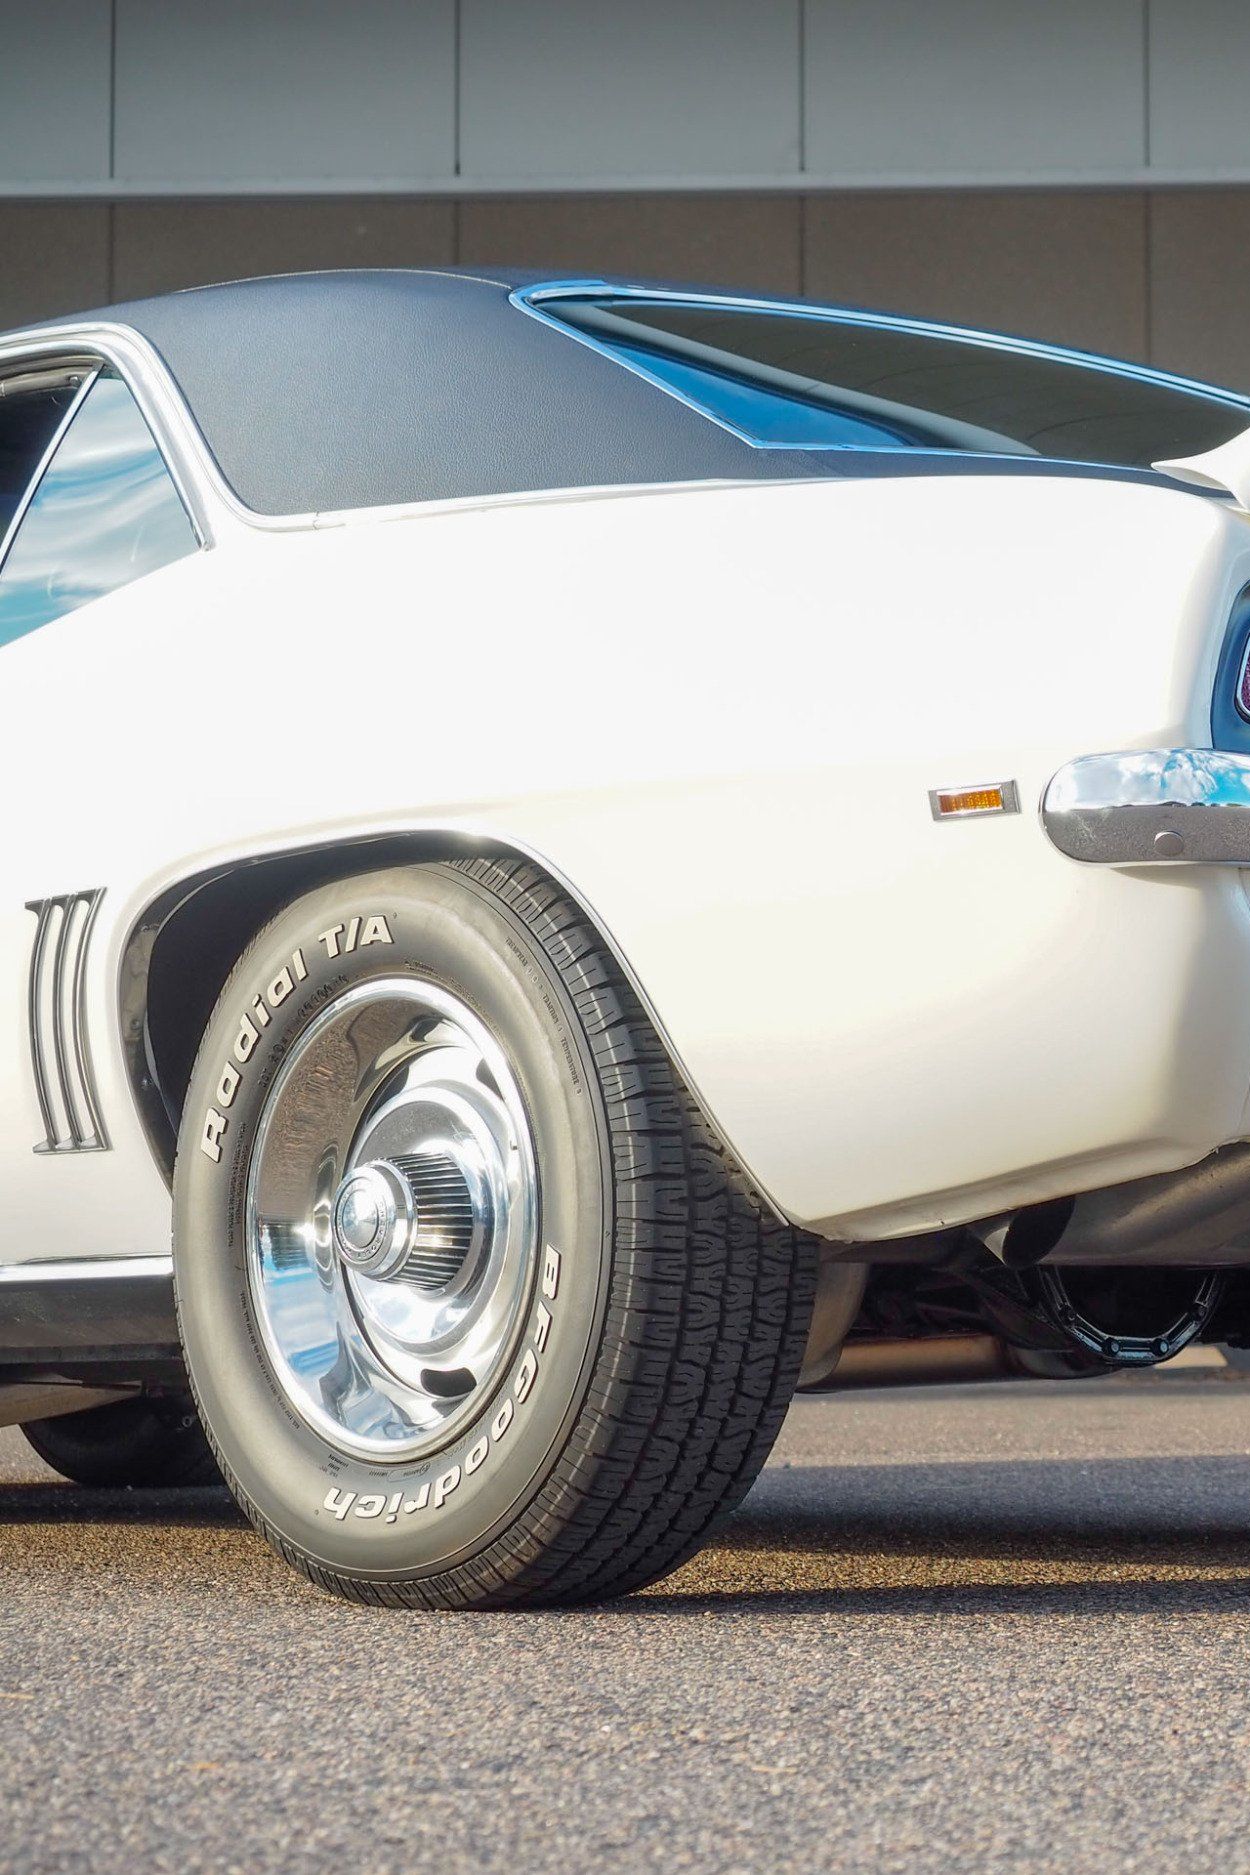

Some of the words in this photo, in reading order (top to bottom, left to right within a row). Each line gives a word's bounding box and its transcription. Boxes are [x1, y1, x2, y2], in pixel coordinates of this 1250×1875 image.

[200, 948, 308, 1163] Radial
[317, 915, 394, 958] T/A
[323, 1243, 561, 1524] BFGoodrich
